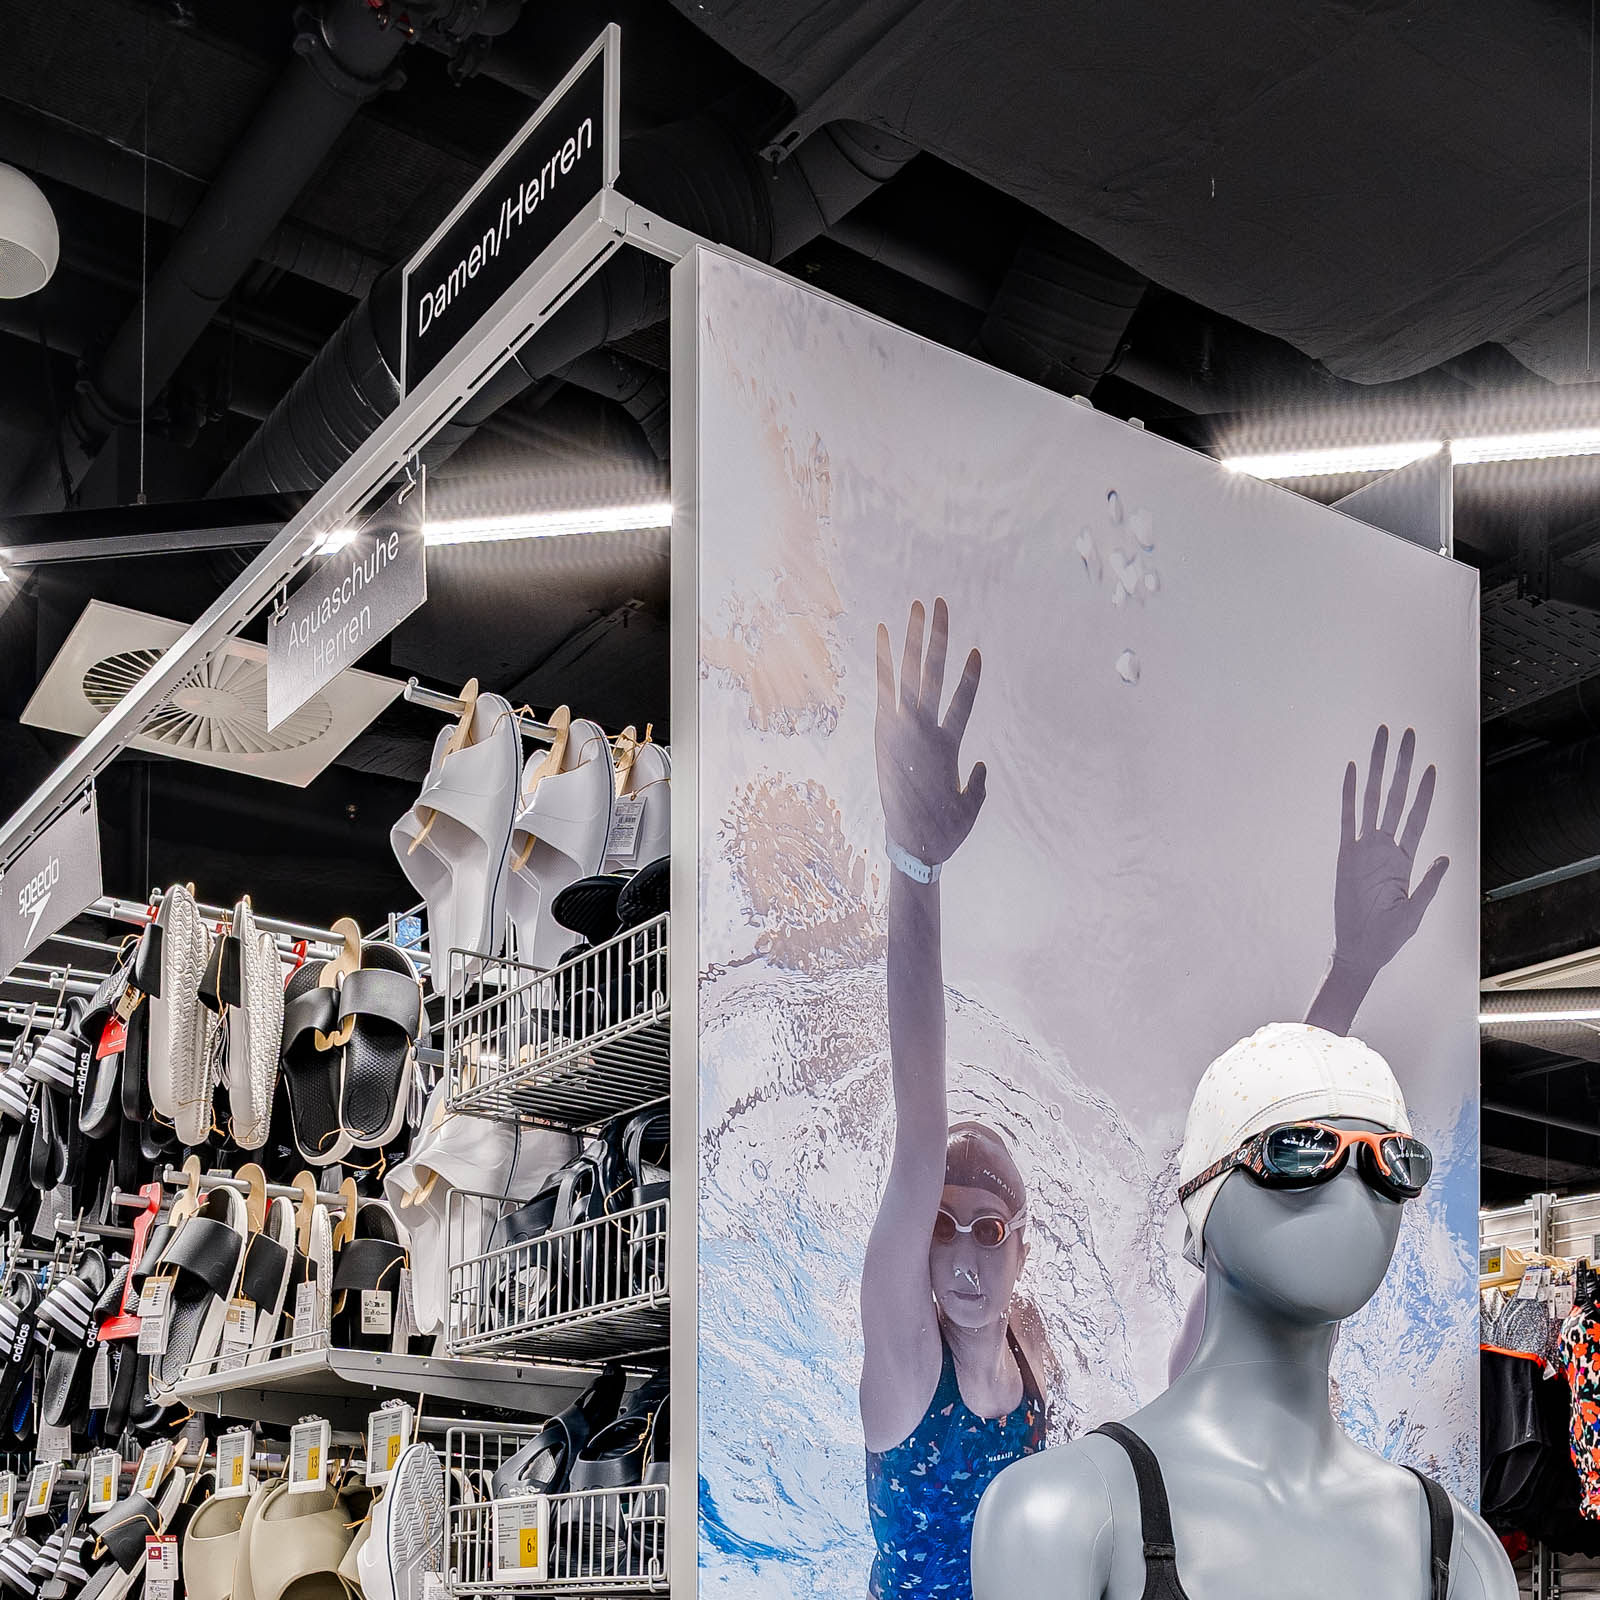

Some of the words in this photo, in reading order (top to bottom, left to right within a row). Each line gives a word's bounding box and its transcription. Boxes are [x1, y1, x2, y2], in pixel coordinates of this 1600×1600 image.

[418, 117, 592, 338] Damen/Herren
[287, 531, 399, 656] Aquaschuhe
[313, 605, 371, 677] Herren
[18, 855, 59, 918] speedo
[76, 1052, 90, 1095] adidas
[12, 1323, 30, 1362] adidas
